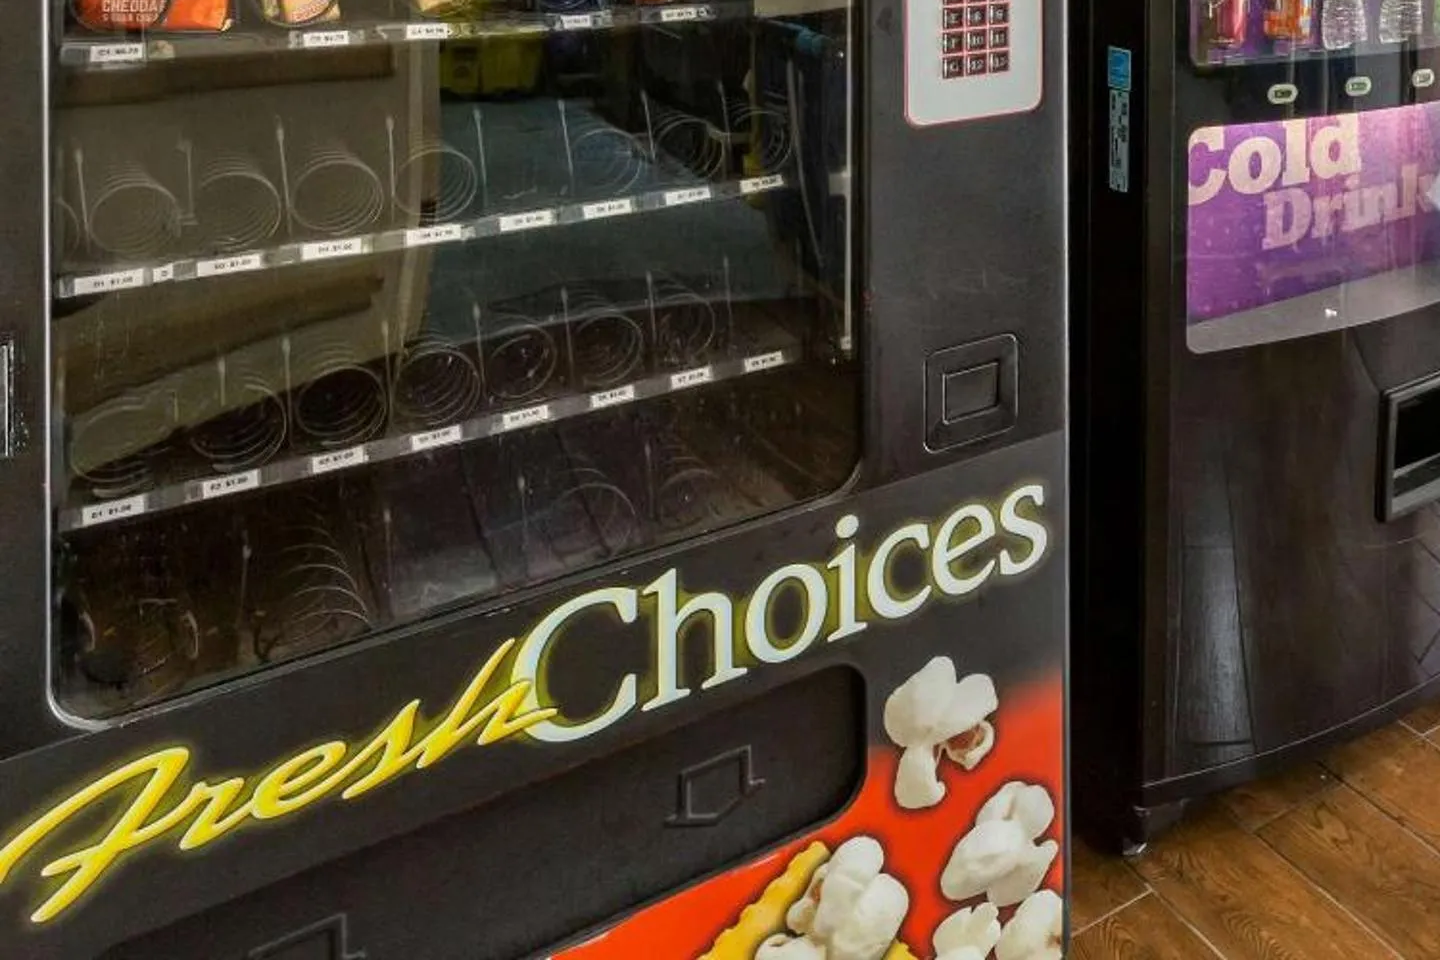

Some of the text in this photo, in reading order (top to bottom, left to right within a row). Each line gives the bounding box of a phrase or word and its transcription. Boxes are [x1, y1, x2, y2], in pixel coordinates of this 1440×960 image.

[1188, 112, 1363, 206] Cold
[0, 483, 1049, 924] Fresh Choices
